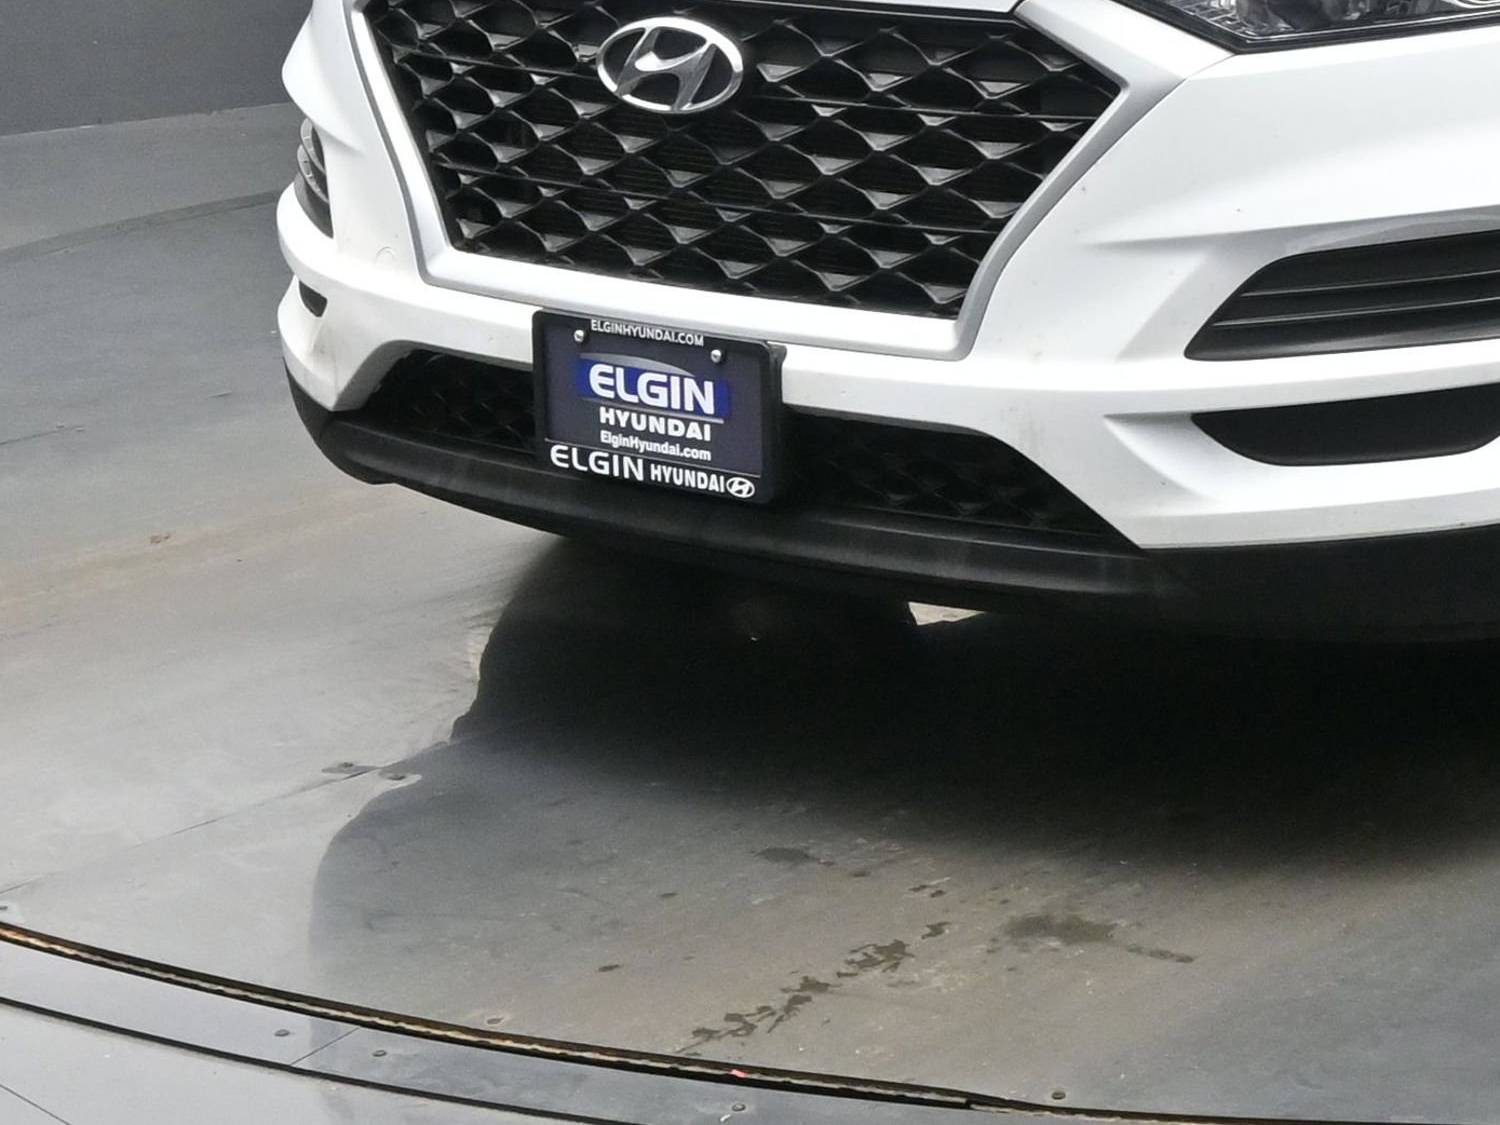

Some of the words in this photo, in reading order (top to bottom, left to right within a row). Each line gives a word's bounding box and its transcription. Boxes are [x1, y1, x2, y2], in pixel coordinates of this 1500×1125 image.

[590, 318, 705, 347] ELGINHYUNDAI.COM
[588, 363, 715, 415] ELGIN
[599, 406, 711, 442] HYUNDAI
[600, 430, 712, 461] ElginHyundai.com
[550, 444, 645, 482] ELGIN
[650, 464, 725, 493] HYUNDAI
